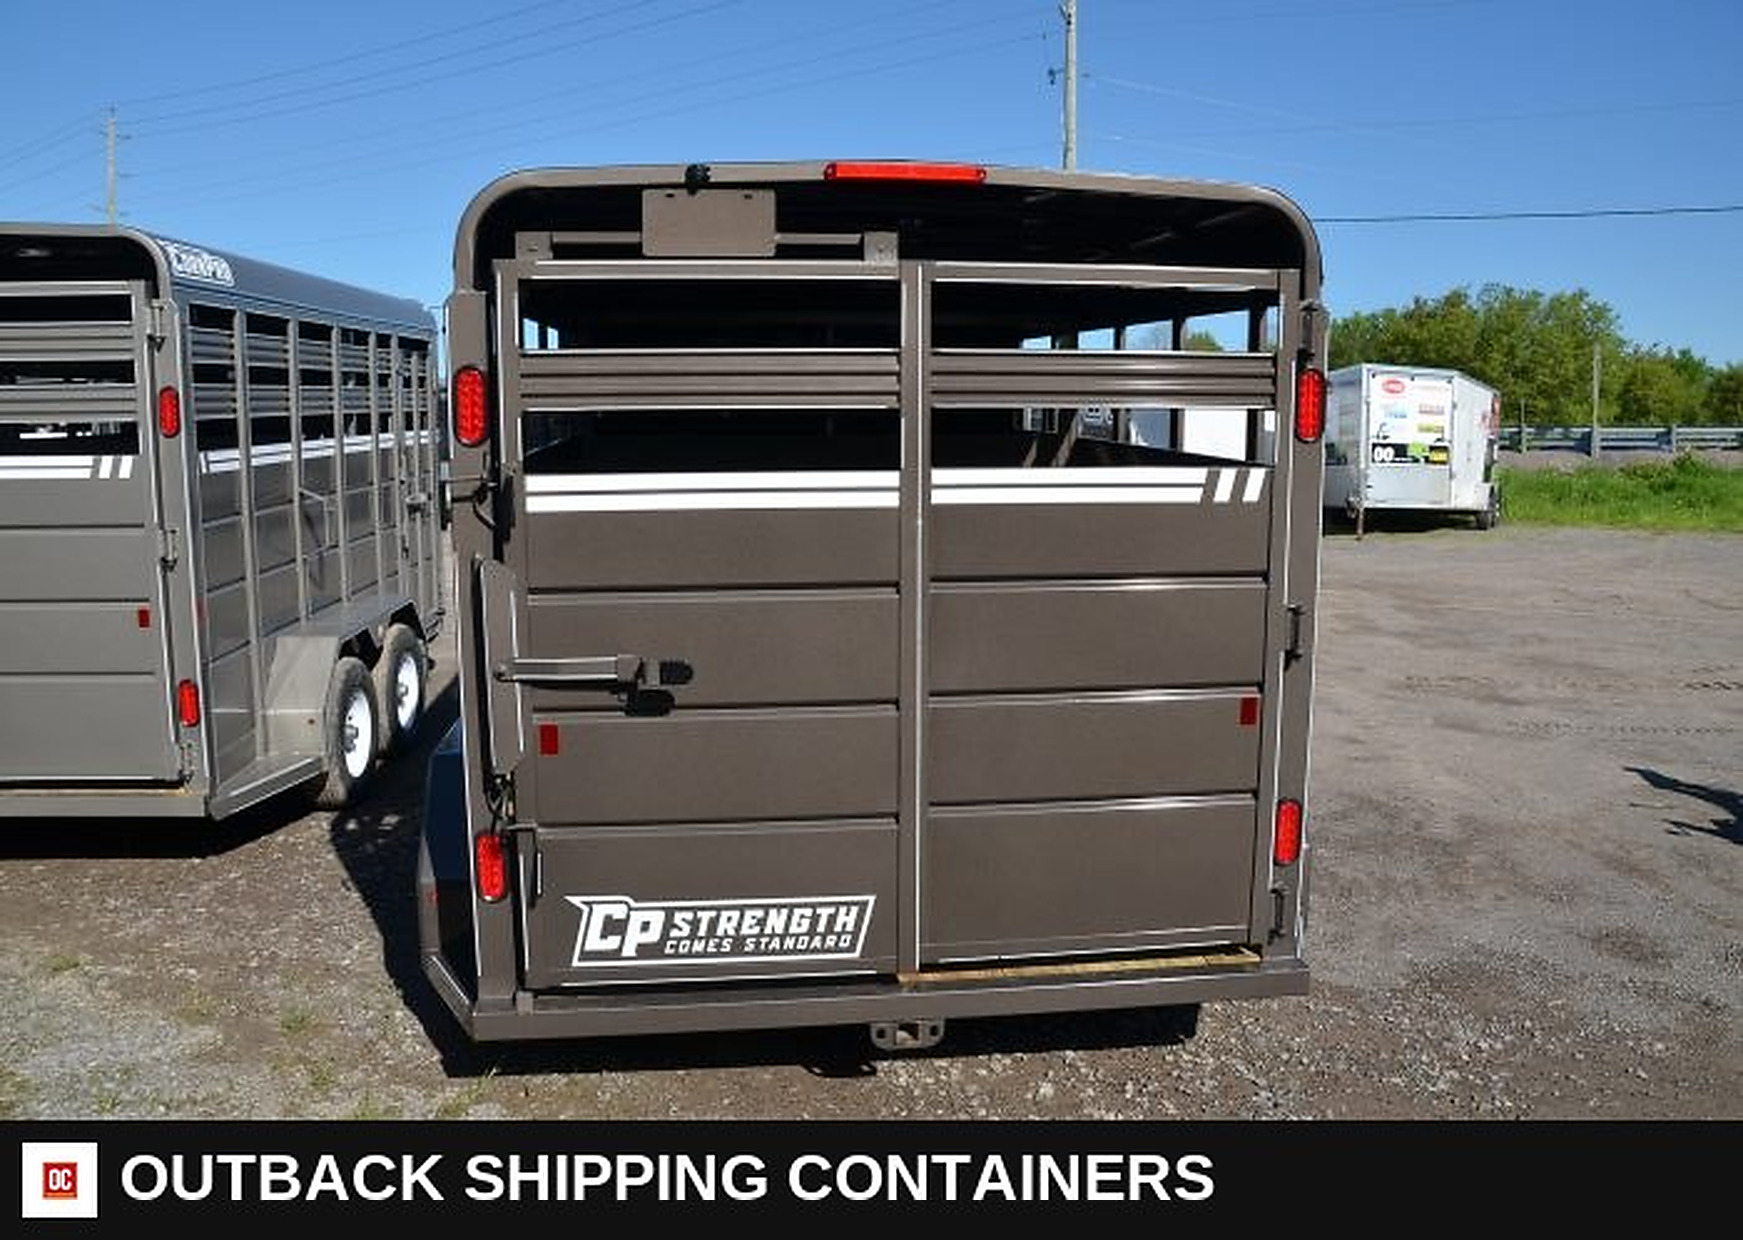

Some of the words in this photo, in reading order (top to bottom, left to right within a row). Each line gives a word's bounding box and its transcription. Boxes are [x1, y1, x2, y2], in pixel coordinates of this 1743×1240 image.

[584, 903, 666, 957] CP
[669, 906, 859, 938] STRENGTH
[664, 938, 733, 954] COMES
[744, 934, 852, 953] STANDARD
